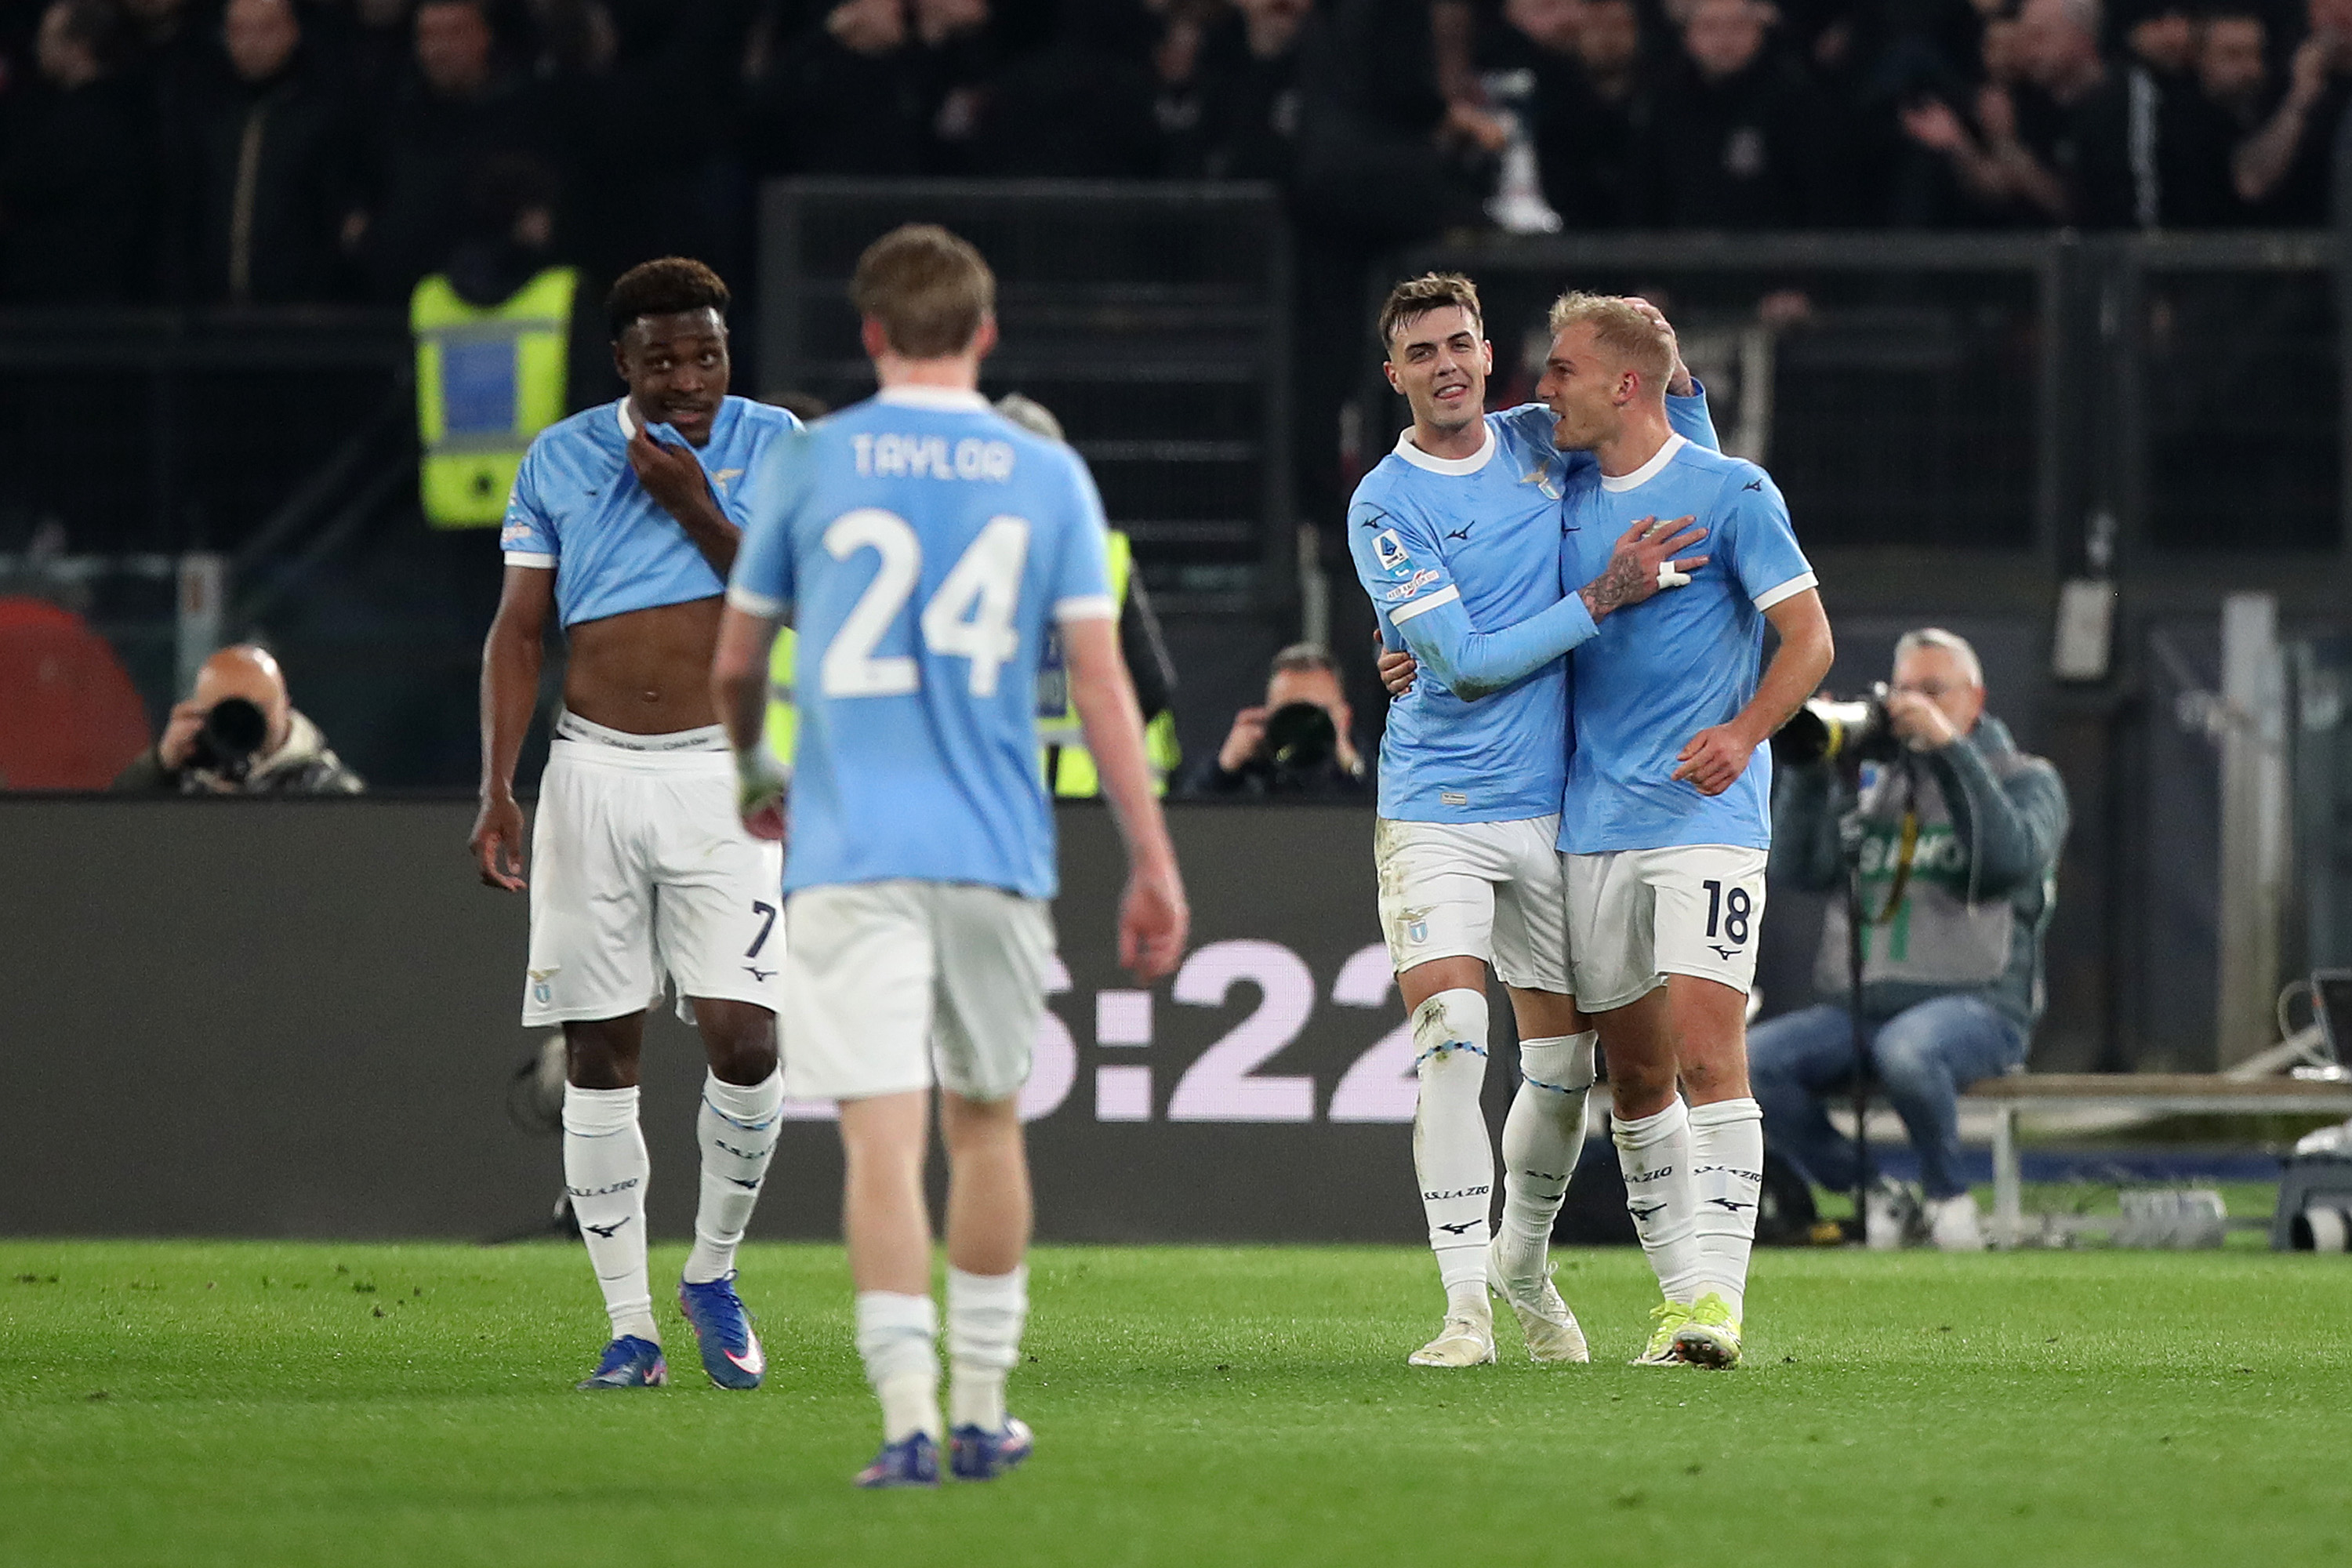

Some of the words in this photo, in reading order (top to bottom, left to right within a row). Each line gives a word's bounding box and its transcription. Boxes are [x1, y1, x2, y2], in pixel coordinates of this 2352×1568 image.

[851, 432, 1017, 483] TAYLOR
[823, 507, 1032, 697] 24
[746, 900, 776, 958] 7
[1702, 879, 1751, 946] 18
